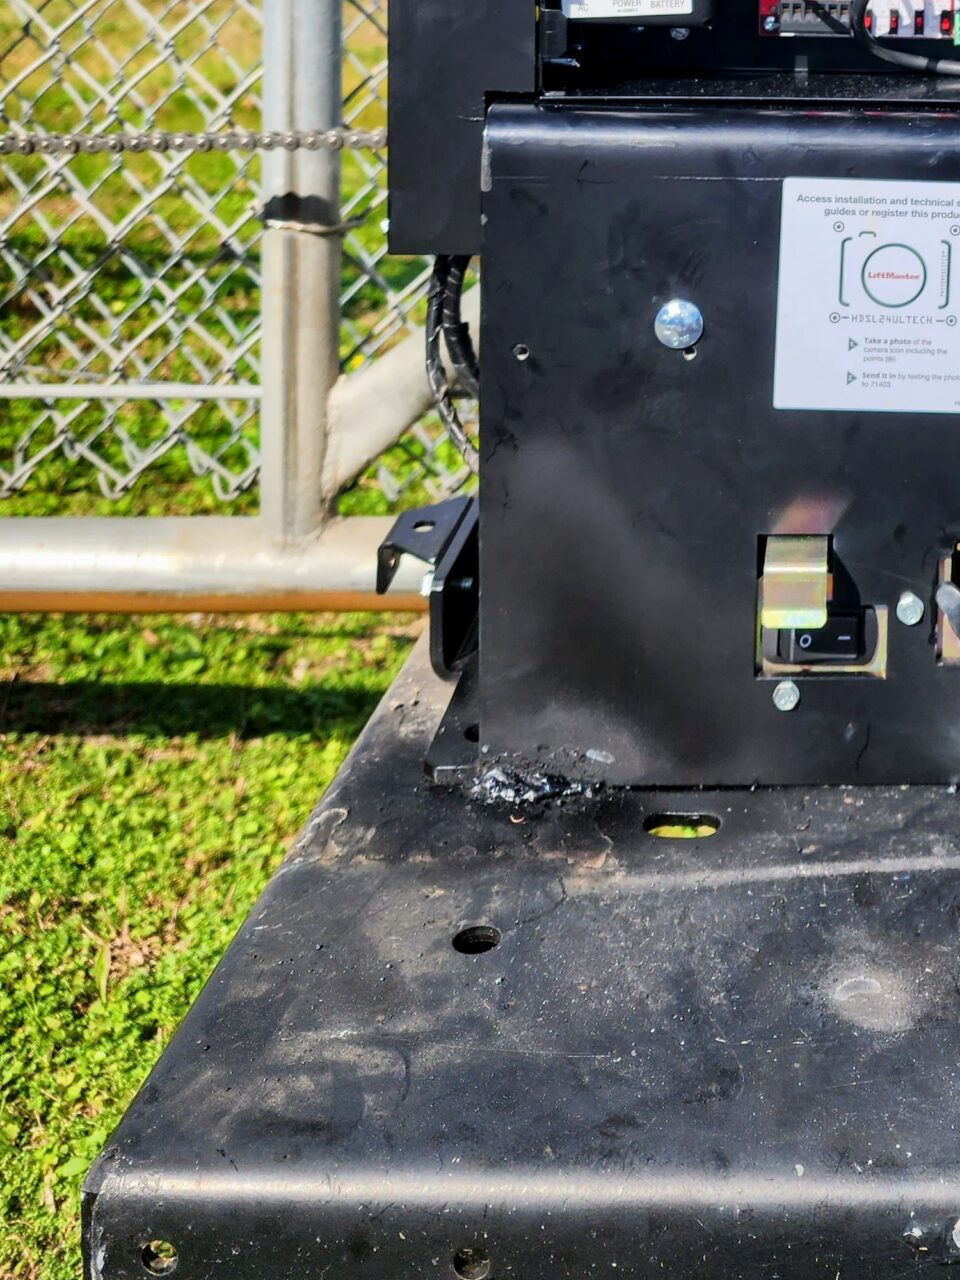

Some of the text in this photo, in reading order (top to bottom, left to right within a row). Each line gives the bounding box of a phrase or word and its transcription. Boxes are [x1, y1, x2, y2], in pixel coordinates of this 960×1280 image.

[650, 0, 685, 9] BATTERY
[796, 194, 832, 203] Access
[834, 195, 887, 205] installation
[889, 198, 908, 206] and
[910, 198, 954, 207] technical
[823, 207, 857, 217] guides
[859, 209, 869, 217] or
[871, 208, 909, 219] register
[911, 209, 929, 218] this
[867, 271, 921, 281] LiftMaster
[864, 337, 881, 345] Take
[889, 338, 912, 346] photo
[921, 338, 932, 346] the
[905, 347, 935, 356] including
[931, 373, 942, 381] the
